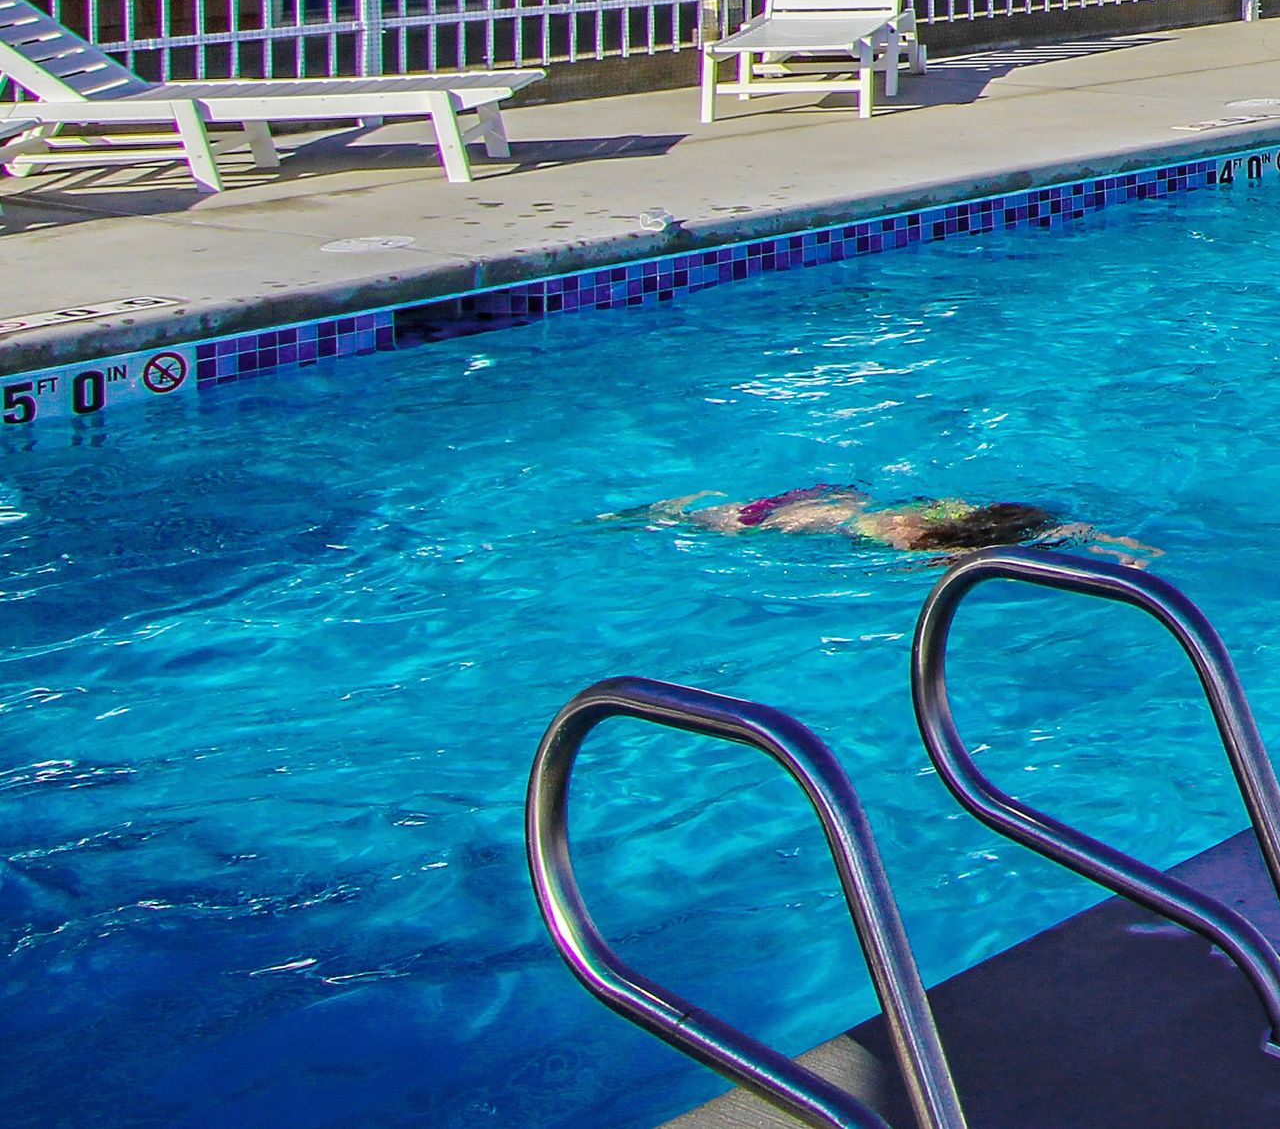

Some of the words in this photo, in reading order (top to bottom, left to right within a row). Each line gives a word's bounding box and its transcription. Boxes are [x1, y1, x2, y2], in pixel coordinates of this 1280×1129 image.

[3, 381, 37, 424] 5
[38, 376, 58, 395] FT
[73, 370, 105, 414] 0
[108, 364, 127, 382] IN
